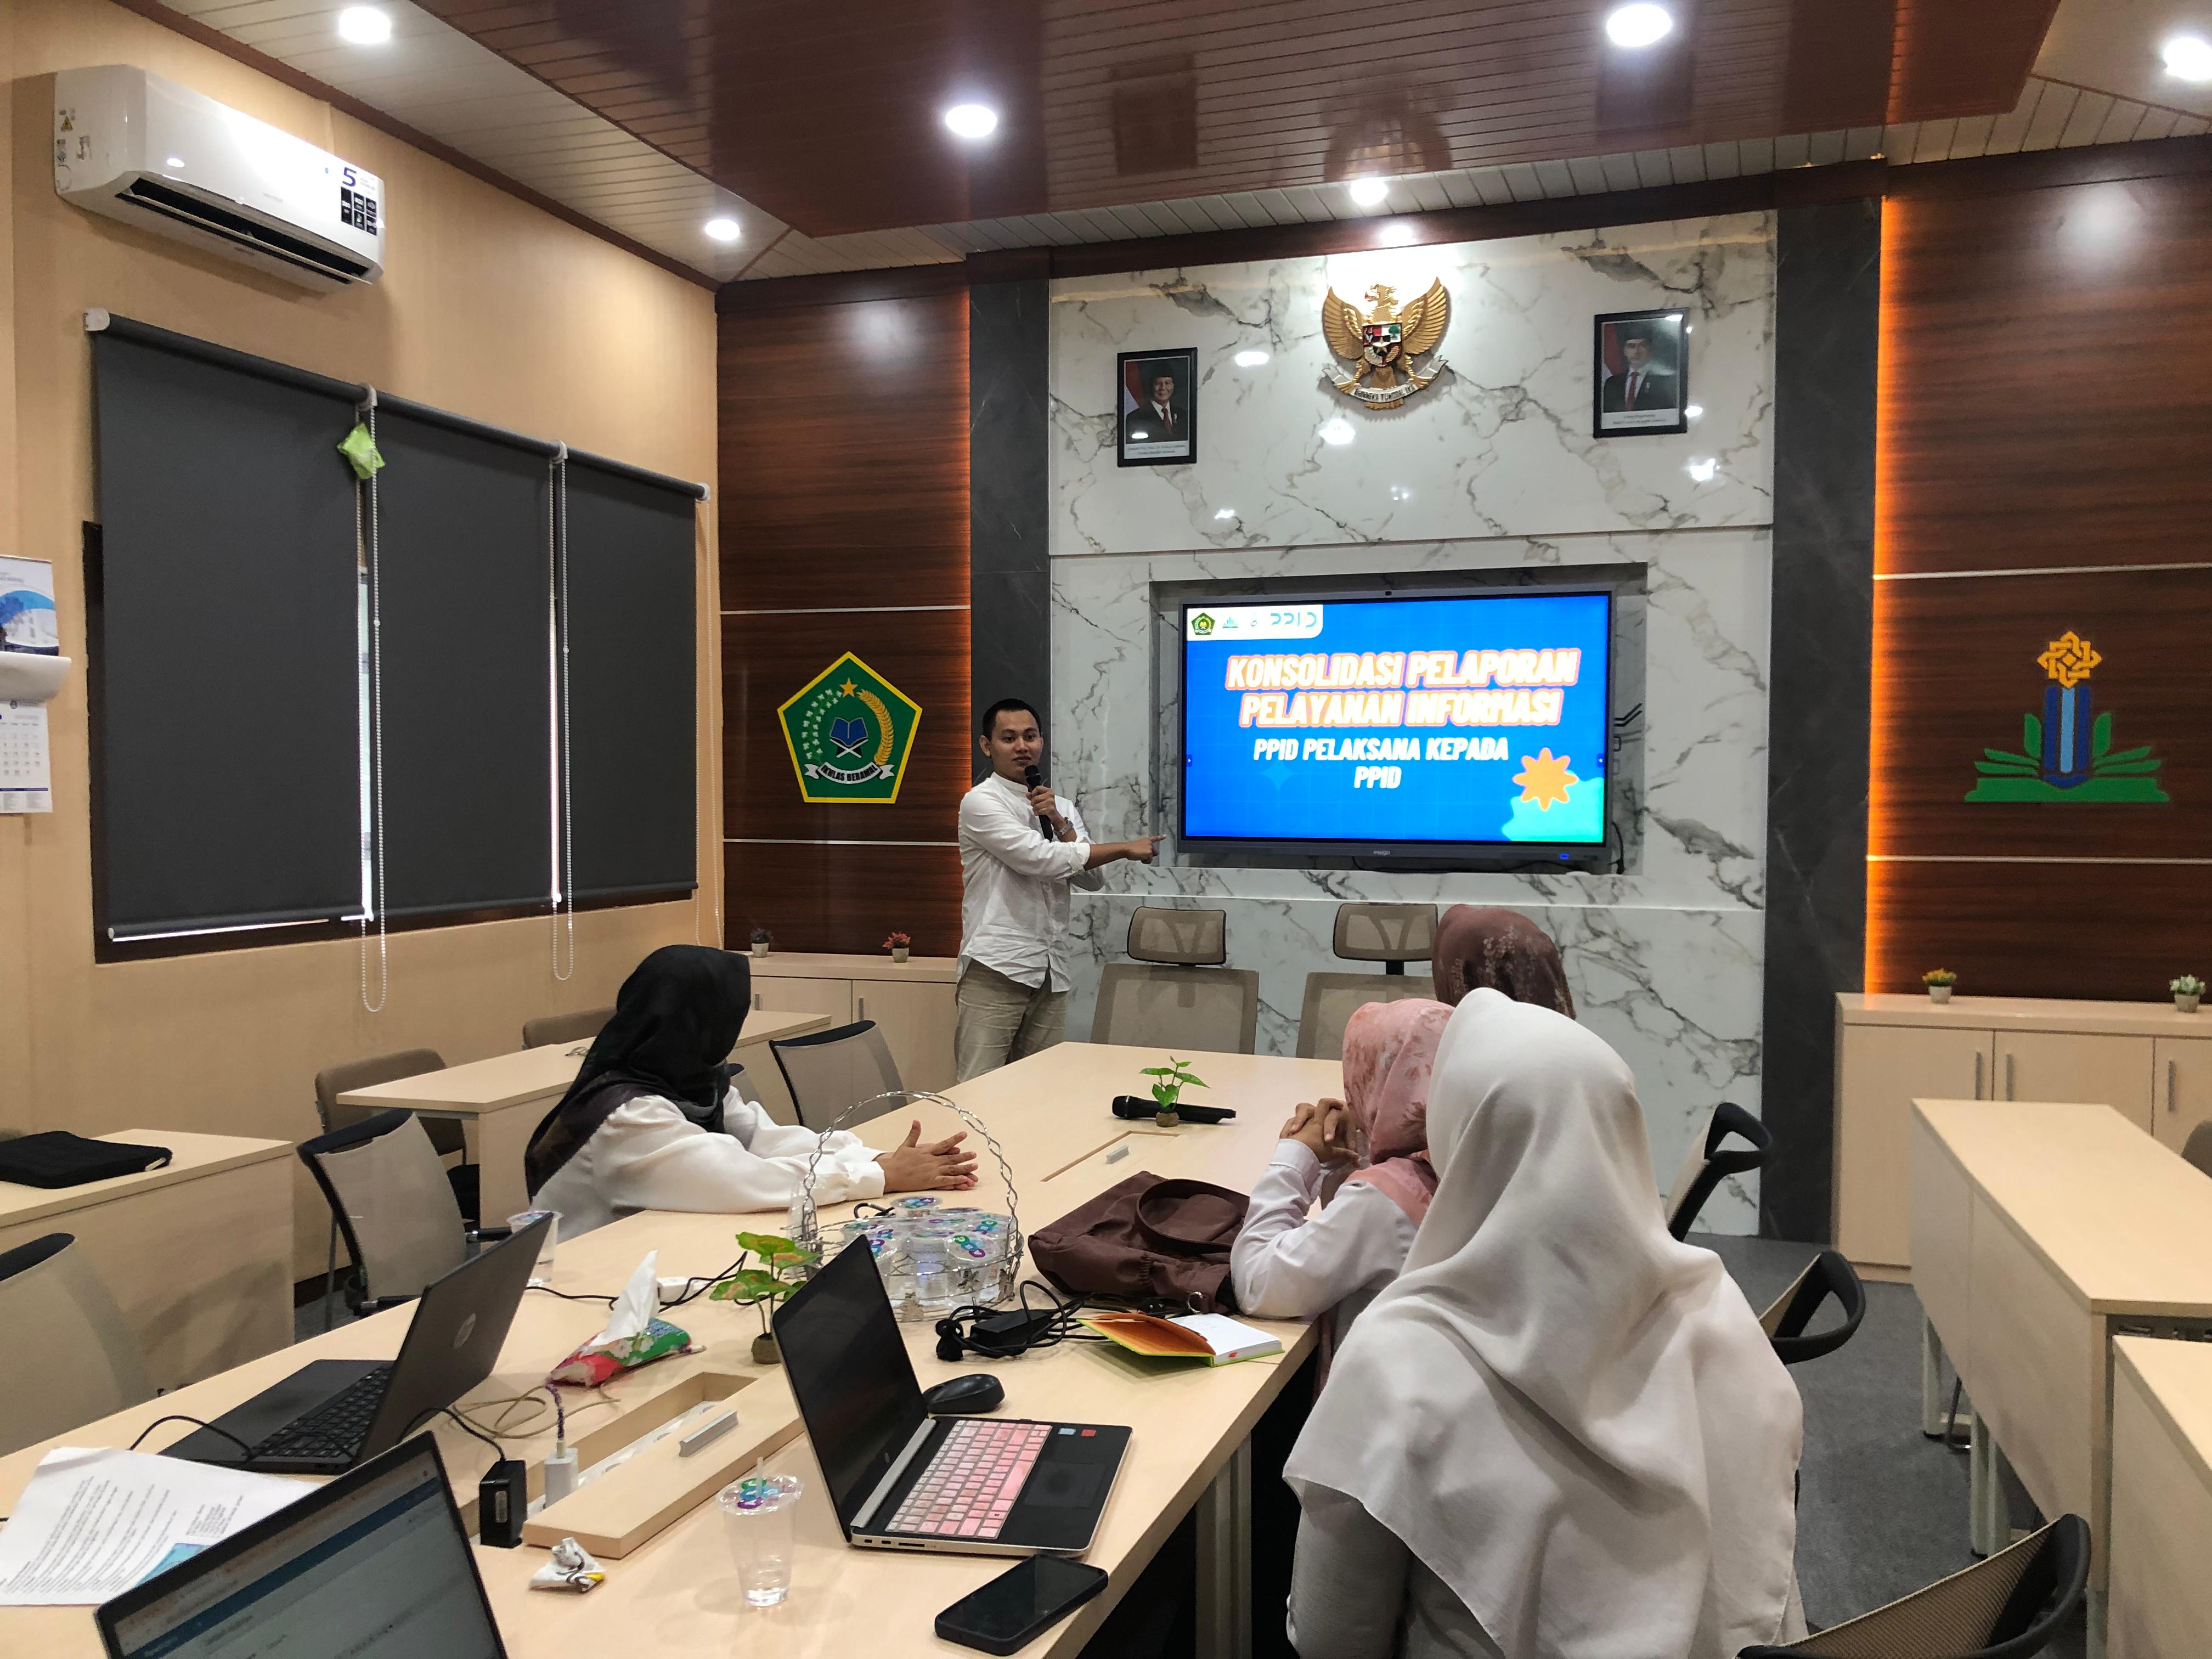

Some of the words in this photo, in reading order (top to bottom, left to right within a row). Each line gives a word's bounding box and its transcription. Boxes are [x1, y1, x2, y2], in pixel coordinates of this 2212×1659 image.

[342, 166, 357, 187] 5
[1226, 653, 1405, 689] KONSOLIDASI
[1406, 648, 1581, 687] PELAPORAN
[1240, 691, 1405, 727] PELAYANAN
[1405, 689, 1563, 726] INFORMASI
[1254, 738, 1299, 760] PPID
[1302, 738, 1420, 760] PELAKSANA
[1425, 737, 1508, 760] KEPADA
[1353, 766, 1402, 788] PPID
